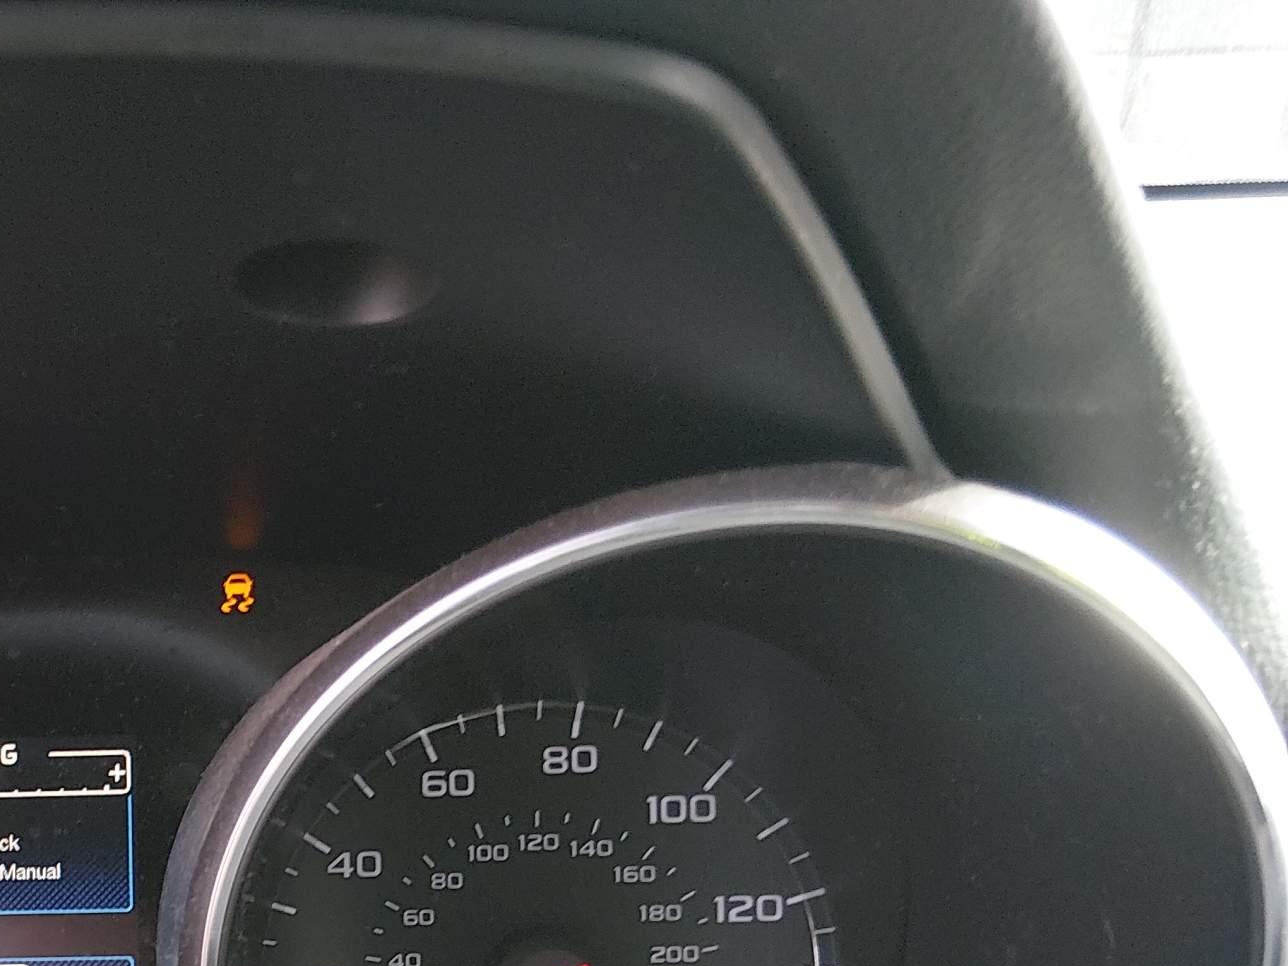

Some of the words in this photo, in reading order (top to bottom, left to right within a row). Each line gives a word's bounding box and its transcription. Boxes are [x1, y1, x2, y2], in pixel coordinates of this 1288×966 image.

[543, 745, 597, 774] 80
[422, 770, 474, 797] 60
[647, 795, 716, 824] 100
[519, 834, 559, 851] 120
[571, 840, 613, 857] 140
[468, 845, 508, 861] 100
[0, 863, 61, 881] Manual
[327, 850, 382, 878] 40
[432, 873, 463, 889] 80
[614, 866, 656, 882] 160
[403, 910, 434, 925] 60
[640, 905, 682, 921] 180
[714, 895, 782, 923] 120
[650, 946, 699, 963] 200
